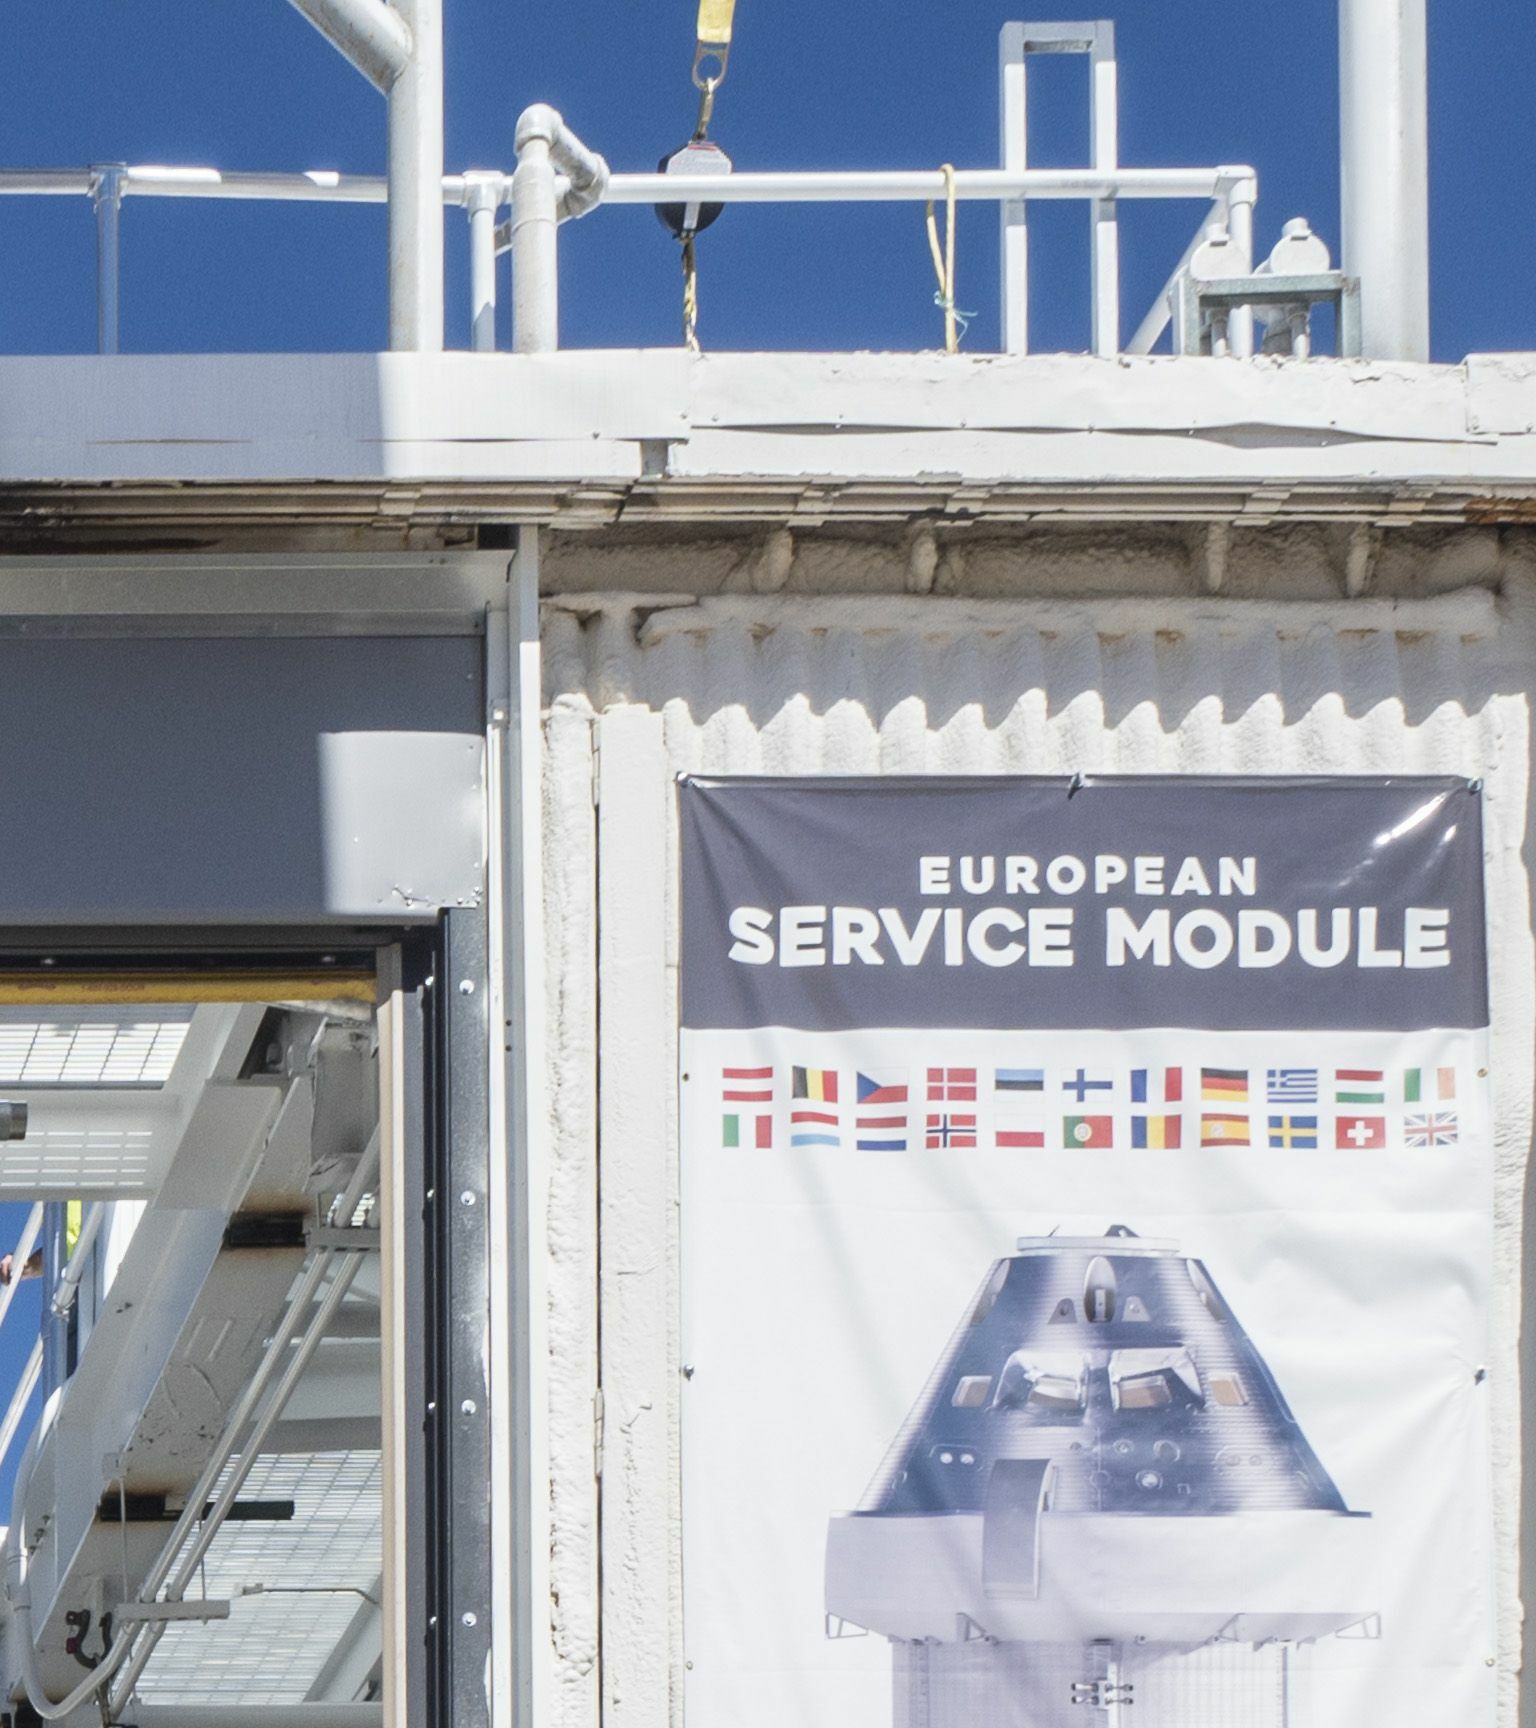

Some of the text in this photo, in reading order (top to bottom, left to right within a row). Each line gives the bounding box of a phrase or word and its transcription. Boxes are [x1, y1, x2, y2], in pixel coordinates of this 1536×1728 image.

[918, 854, 1258, 897] EUROPEAN
[727, 903, 1452, 969] SERVICE MODULE
